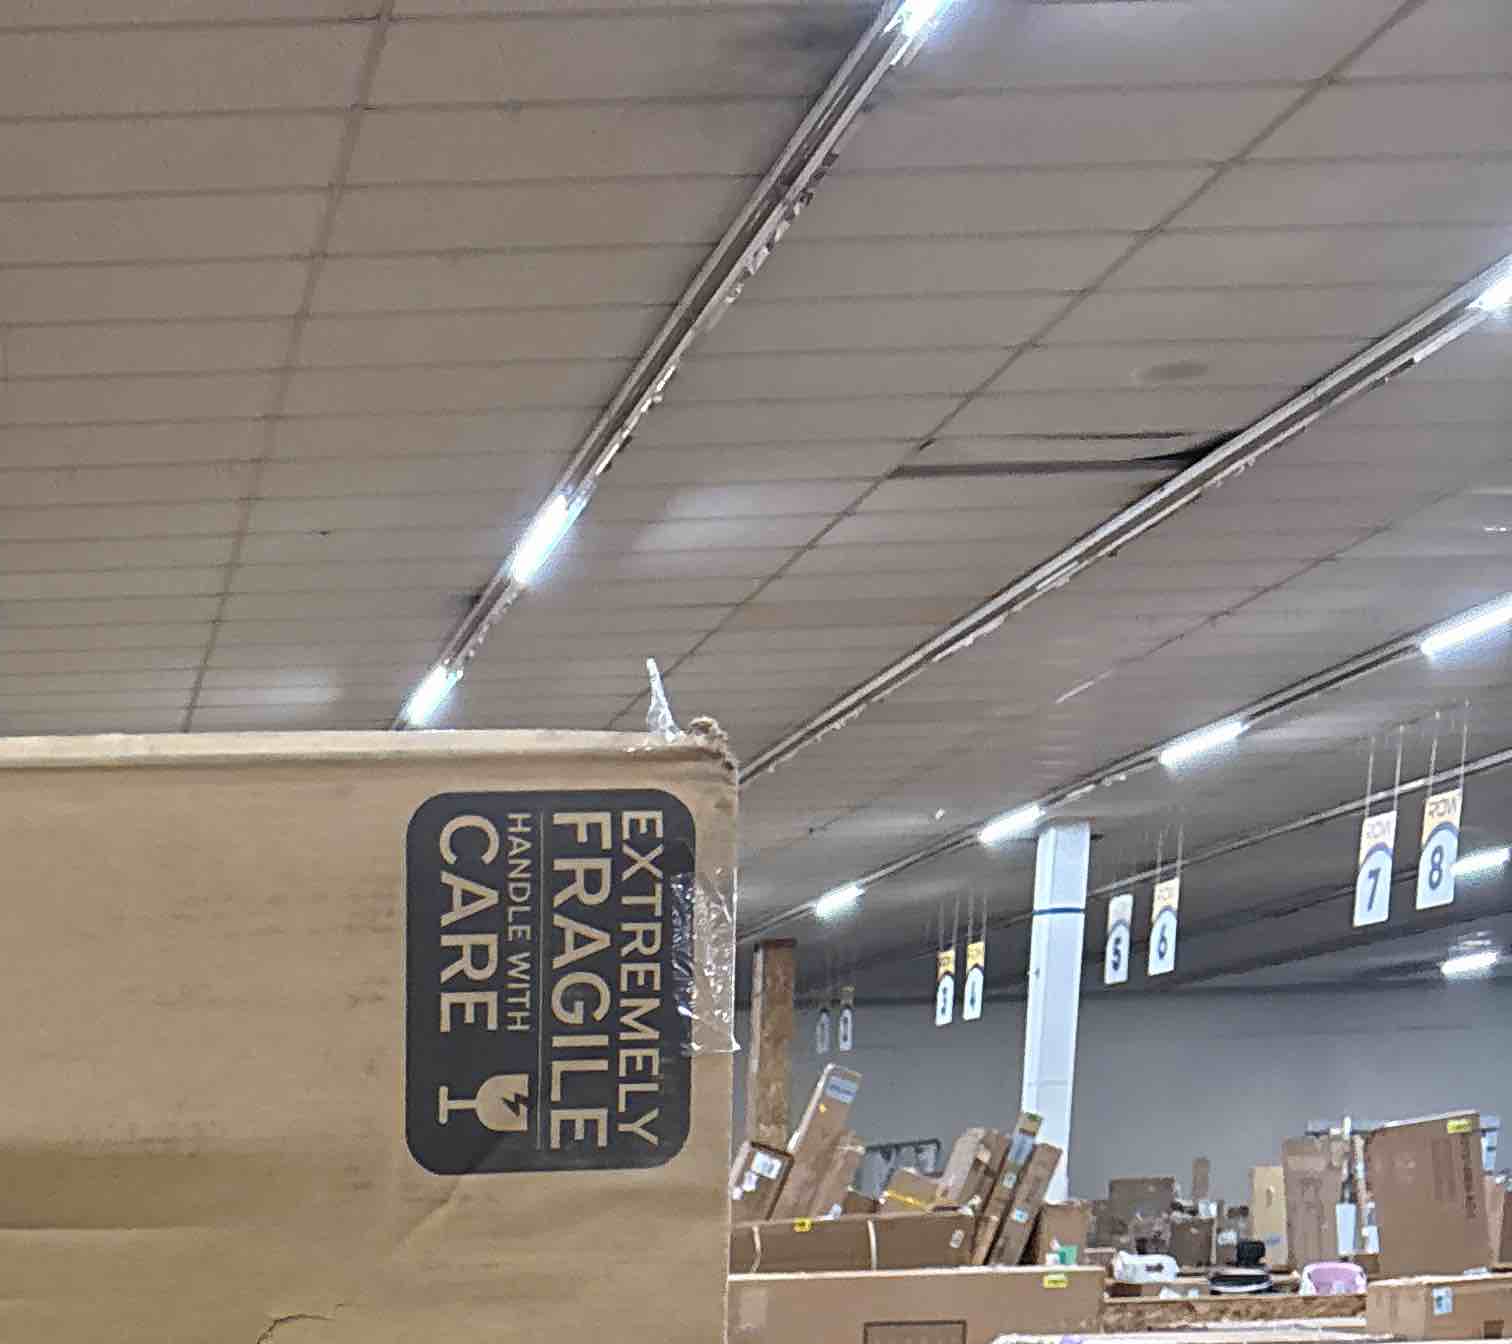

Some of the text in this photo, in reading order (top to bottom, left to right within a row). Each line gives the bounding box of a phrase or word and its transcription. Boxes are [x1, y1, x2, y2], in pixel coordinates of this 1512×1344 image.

[438, 814, 500, 1033] CARE
[505, 812, 533, 1033] HANDLE WITH
[1367, 866, 1382, 913] 7
[1428, 844, 1445, 891] 8
[550, 810, 613, 1150] FRAGILE
[617, 809, 665, 1146] EXTREMELY
[1112, 936, 1123, 972] 5
[1157, 922, 1168, 961] 6
